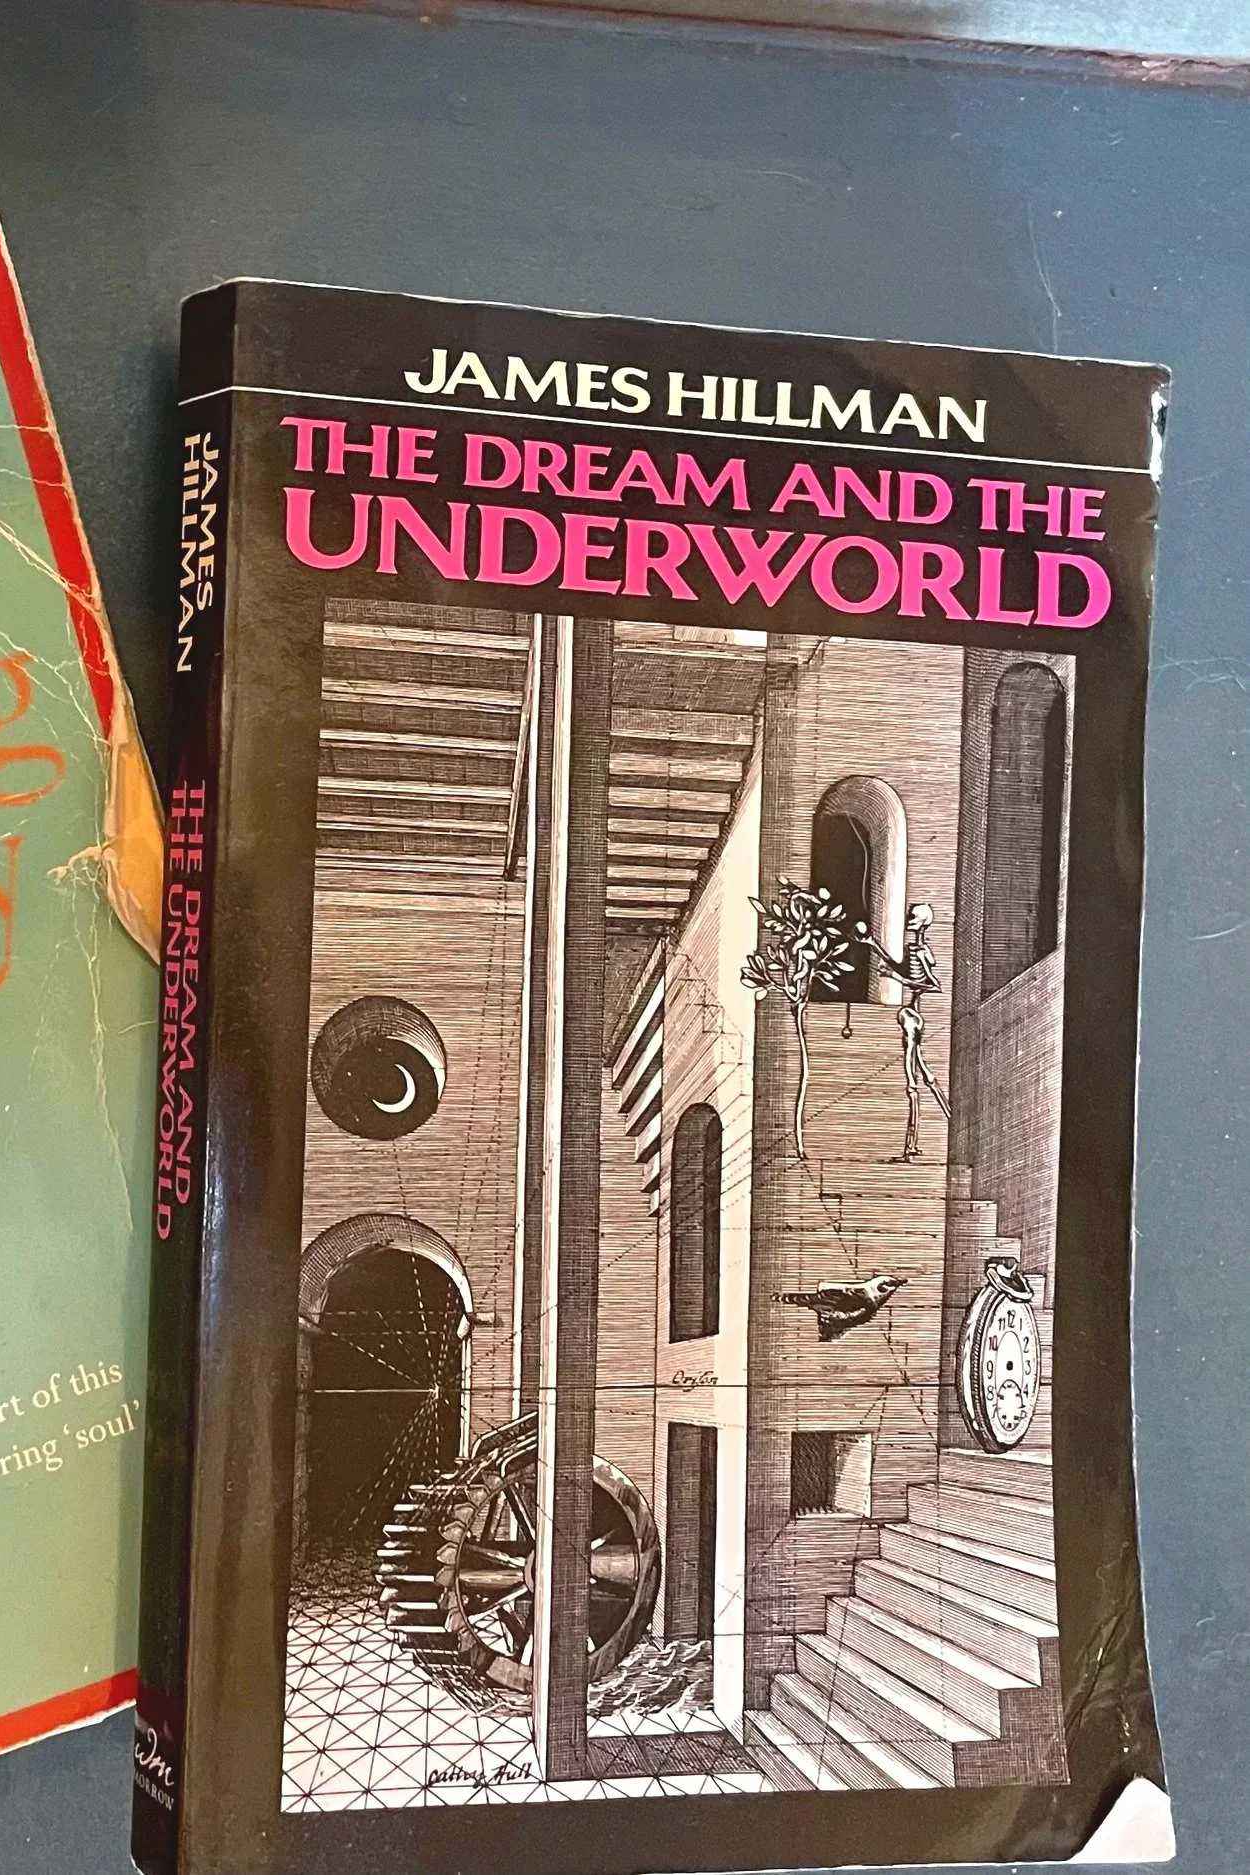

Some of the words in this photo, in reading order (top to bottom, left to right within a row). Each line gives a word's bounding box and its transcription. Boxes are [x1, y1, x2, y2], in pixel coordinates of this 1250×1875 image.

[404, 349, 650, 413] JAMES
[668, 371, 989, 443] HILLMAN
[196, 432, 219, 611] JAMES
[279, 417, 438, 483] THE
[465, 433, 750, 511] DREAM
[775, 457, 952, 524] AND
[967, 479, 1105, 541] THE
[176, 433, 201, 672] HILLMAN
[281, 488, 1112, 629] UNDERWORLD
[170, 780, 188, 873] THE
[188, 780, 206, 873] THE
[179, 890, 201, 1070] DREAM
[156, 885, 186, 1241] UNDERWORLD
[176, 1089, 194, 1204] AND
[32, 1373, 61, 1410] of
[69, 1361, 123, 1397] this
